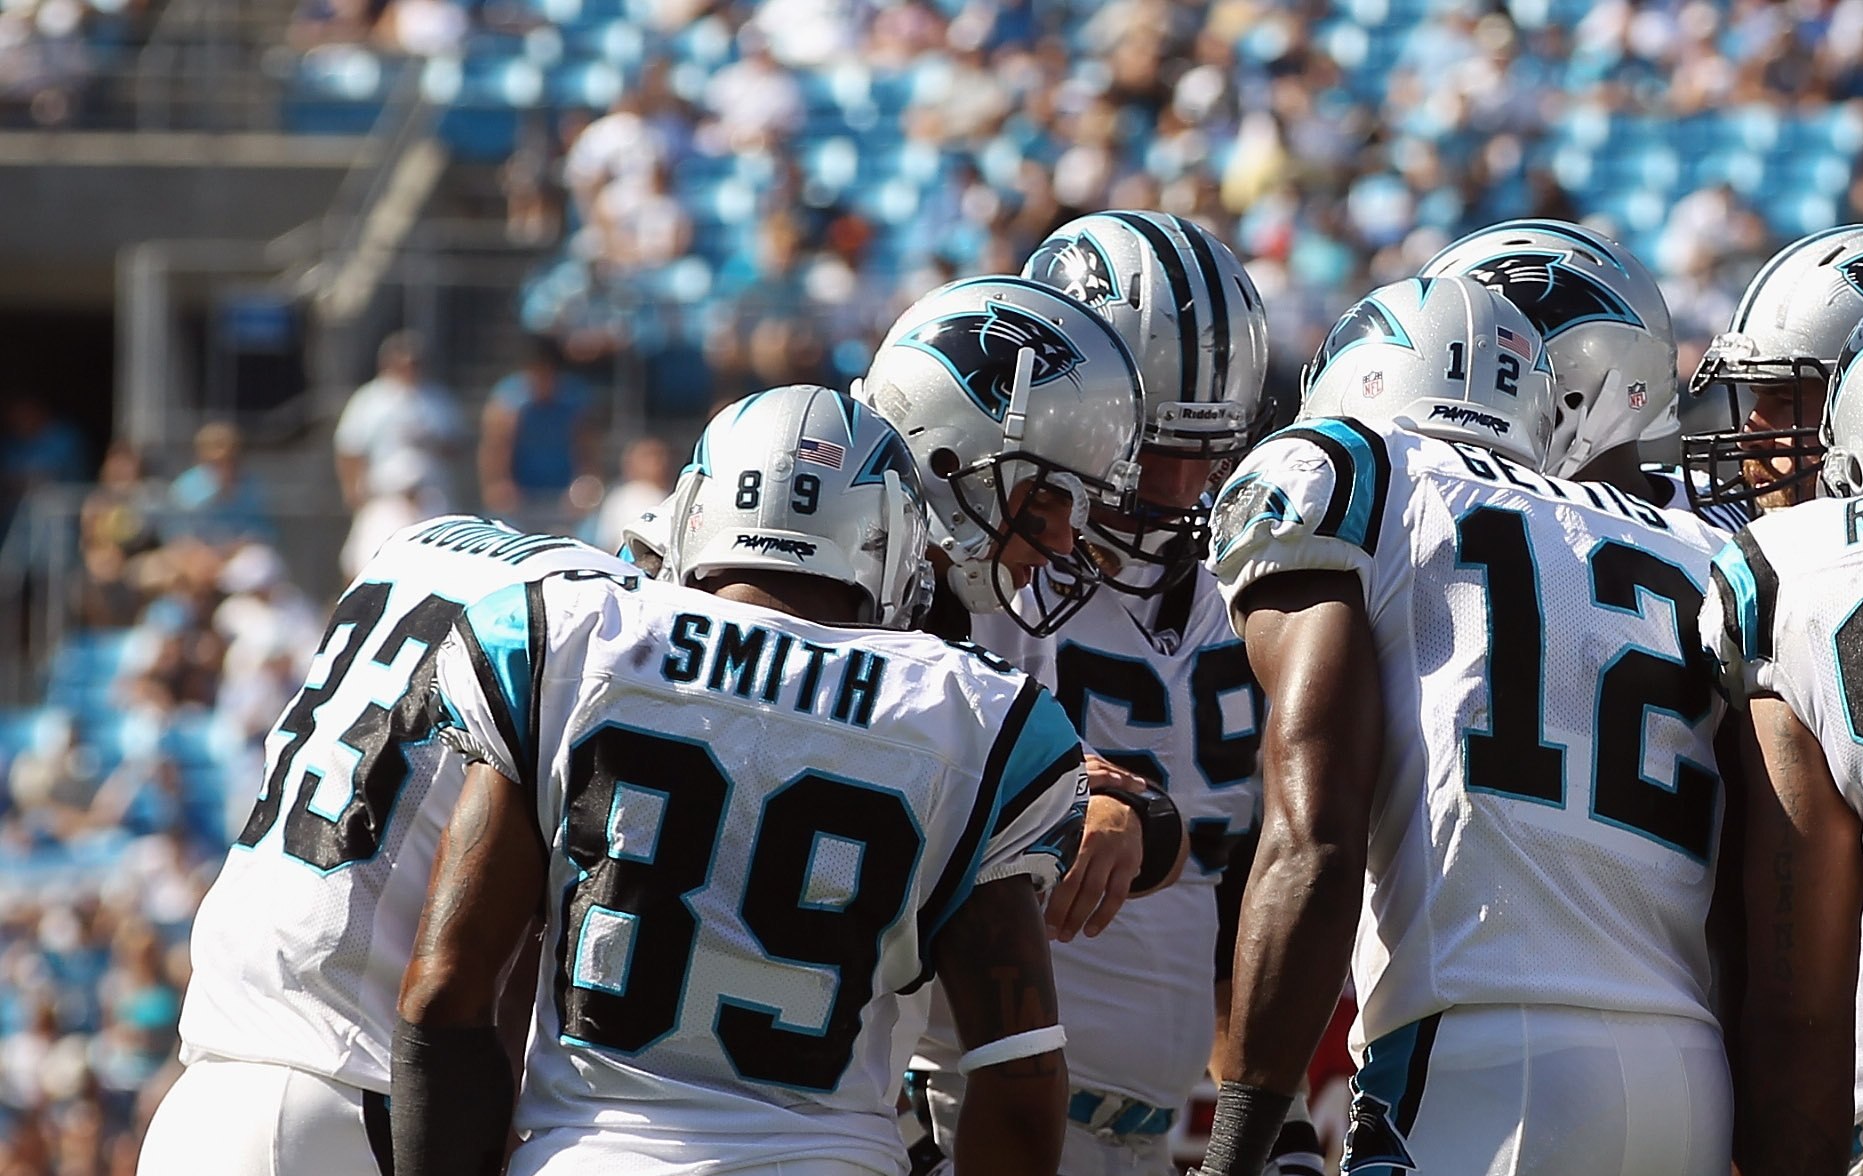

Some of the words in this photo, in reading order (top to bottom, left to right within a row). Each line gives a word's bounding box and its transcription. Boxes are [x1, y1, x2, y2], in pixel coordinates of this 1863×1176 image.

[1428, 404, 1511, 434] PANTHERS
[731, 534, 818, 562] PANTHERS
[662, 612, 886, 728] SMITH
[1455, 503, 1720, 866] 12
[556, 718, 926, 1092] 89
